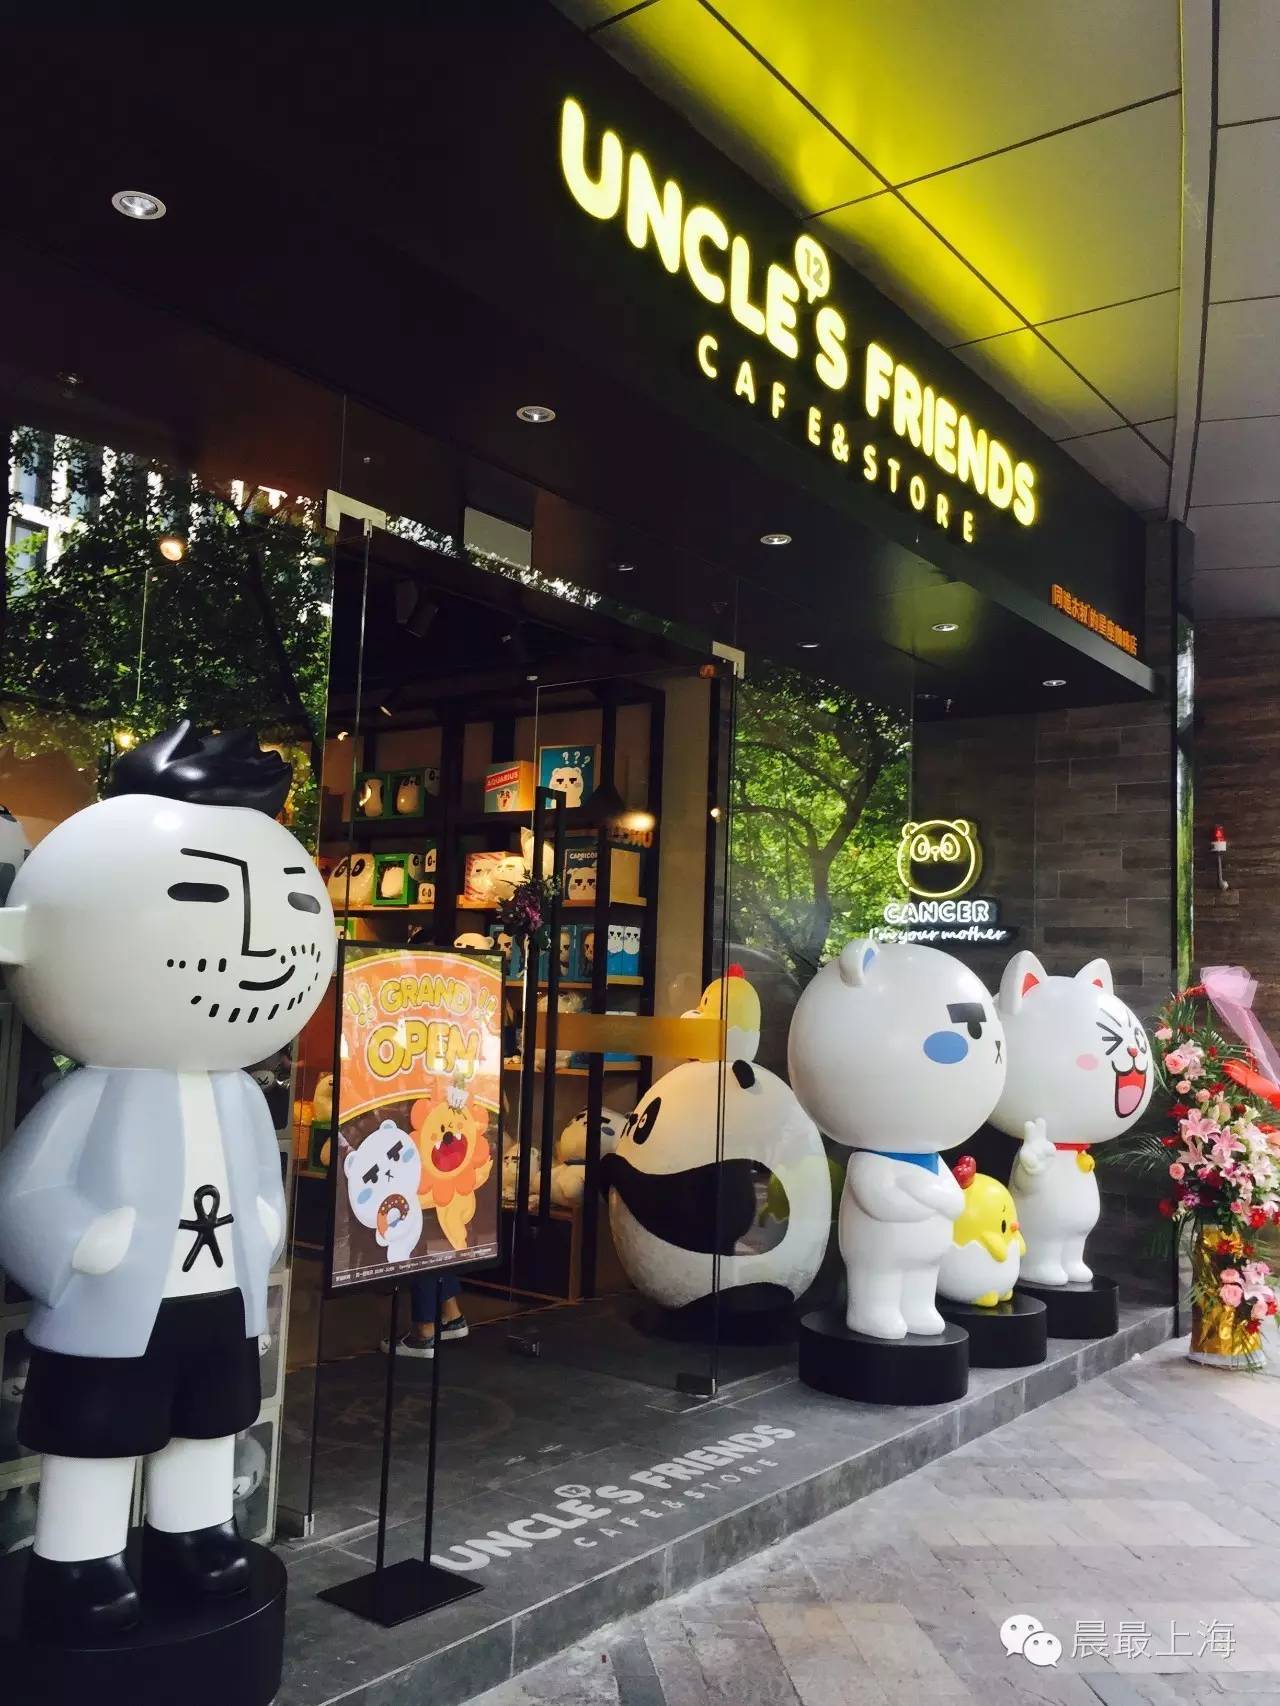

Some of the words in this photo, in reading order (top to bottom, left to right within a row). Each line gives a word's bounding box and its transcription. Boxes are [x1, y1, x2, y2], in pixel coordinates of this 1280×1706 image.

[560, 97, 848, 391] UNCLE'S
[864, 342, 1037, 527] FRIENDS
[883, 900, 990, 924] CANCER
[899, 930, 940, 944] your
[942, 926, 1006, 942] mother
[379, 974, 473, 1015] GRAND
[366, 1020, 481, 1080] OPEN
[630, 1425, 796, 1489] FRIENDS
